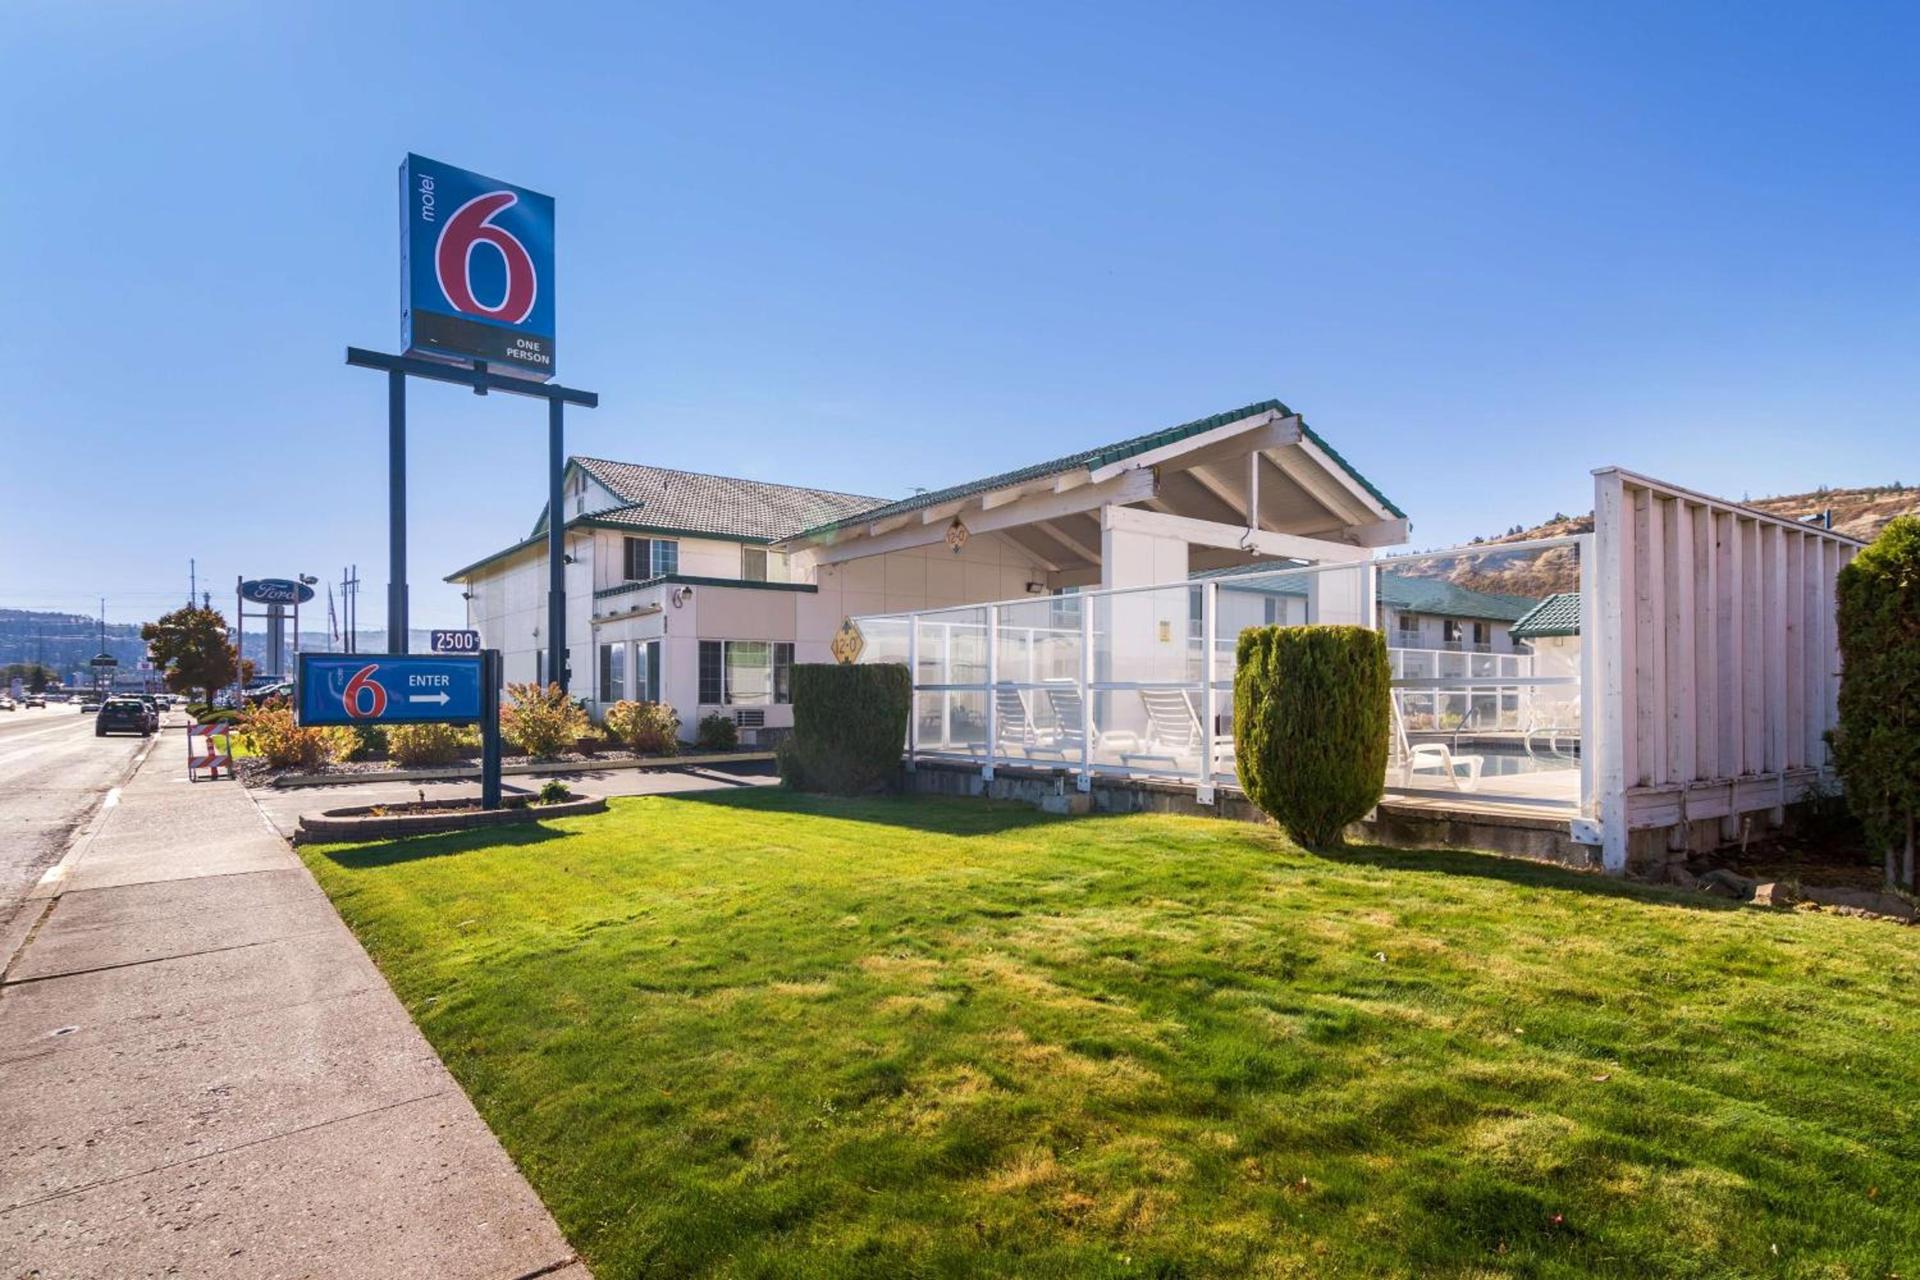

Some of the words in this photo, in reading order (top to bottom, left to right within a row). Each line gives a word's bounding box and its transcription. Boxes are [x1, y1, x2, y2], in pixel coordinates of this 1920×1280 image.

[418, 173, 435, 222] motel
[435, 190, 537, 325] 6
[516, 338, 541, 352] ONE
[506, 347, 550, 365] PERSON
[436, 632, 473, 649] 2500
[409, 674, 450, 687] ENTER
[343, 663, 388, 718] 6
